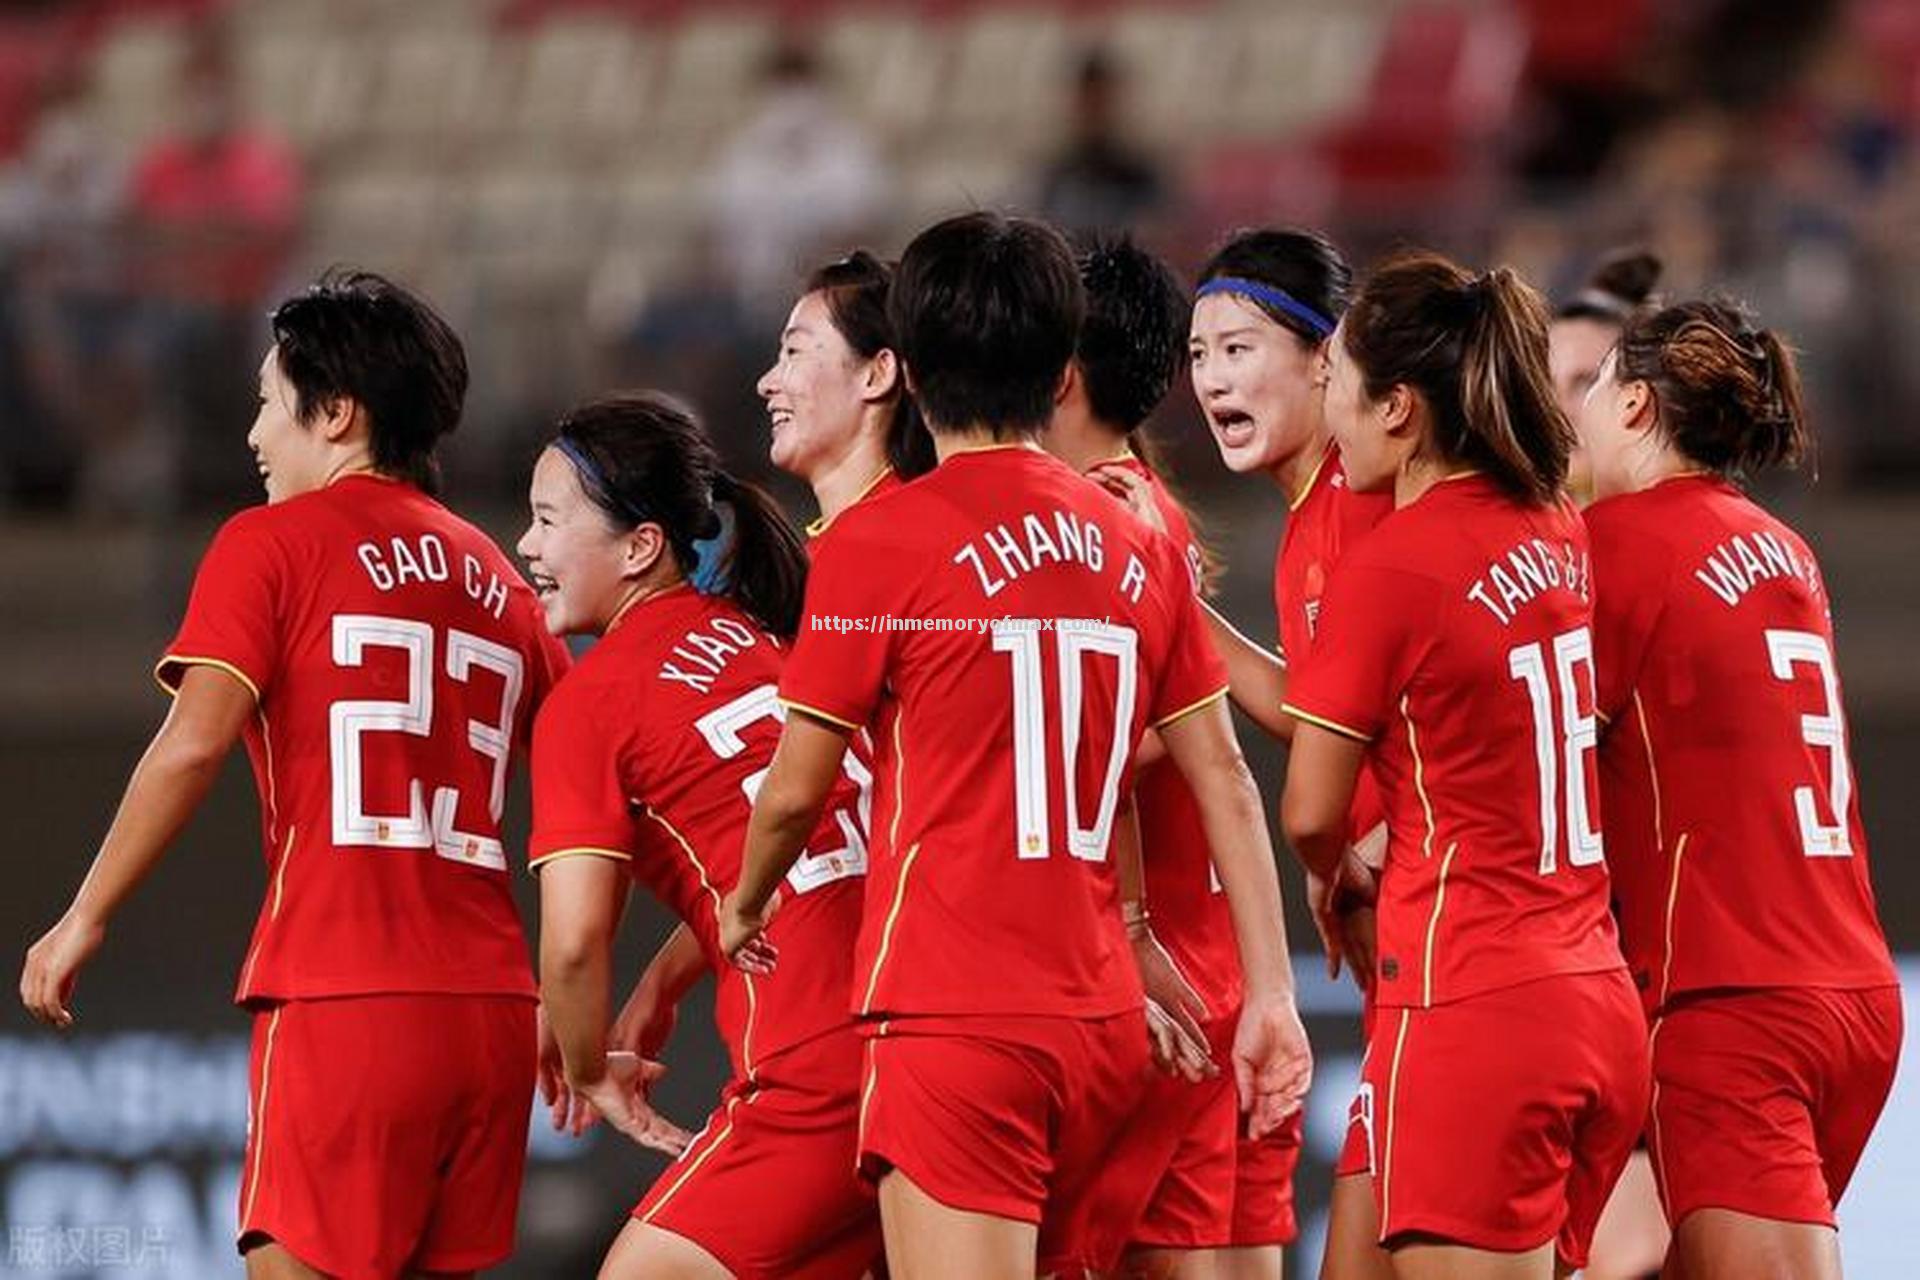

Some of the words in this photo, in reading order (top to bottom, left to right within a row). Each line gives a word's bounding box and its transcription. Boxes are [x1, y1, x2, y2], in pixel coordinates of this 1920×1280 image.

[357, 533, 449, 592] GAO
[464, 553, 509, 618] CH
[954, 511, 1103, 598] ZHANG
[1120, 553, 1147, 603] R
[1467, 538, 1560, 625] TANG
[659, 618, 757, 693] XIAO
[330, 614, 524, 871] 23
[992, 617, 1138, 862] 10
[1764, 629, 1854, 857] 3
